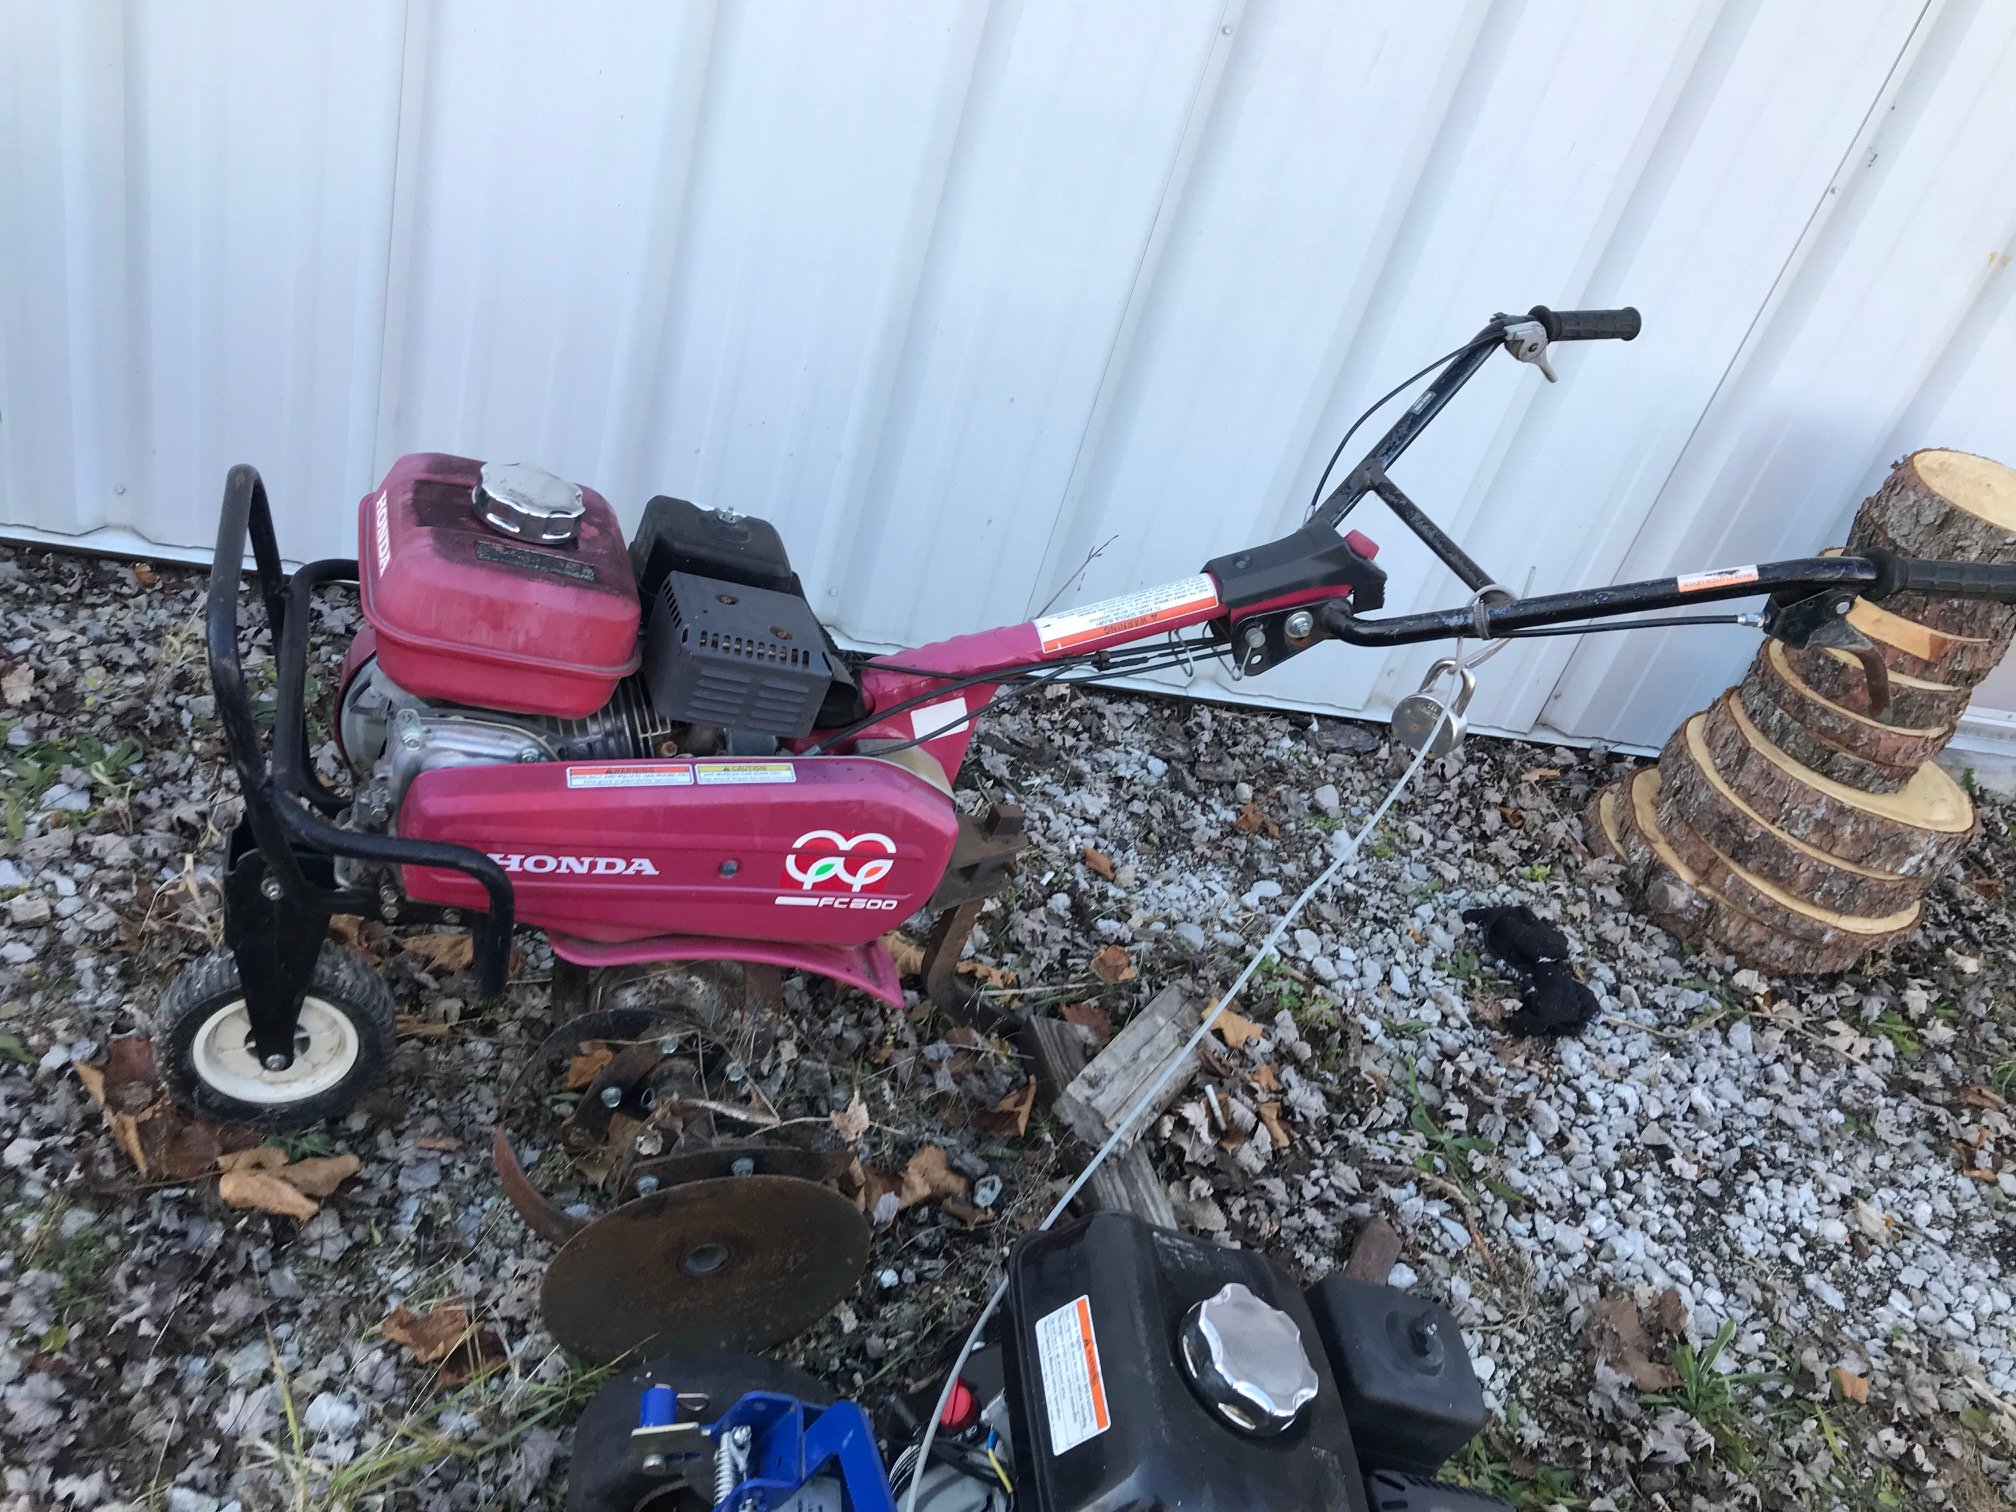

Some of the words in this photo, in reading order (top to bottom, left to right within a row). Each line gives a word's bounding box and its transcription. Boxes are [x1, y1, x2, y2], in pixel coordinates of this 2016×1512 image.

[376, 488, 391, 578] HONDA
[1102, 616, 1147, 634] WARNING
[486, 853, 660, 875] HONDA
